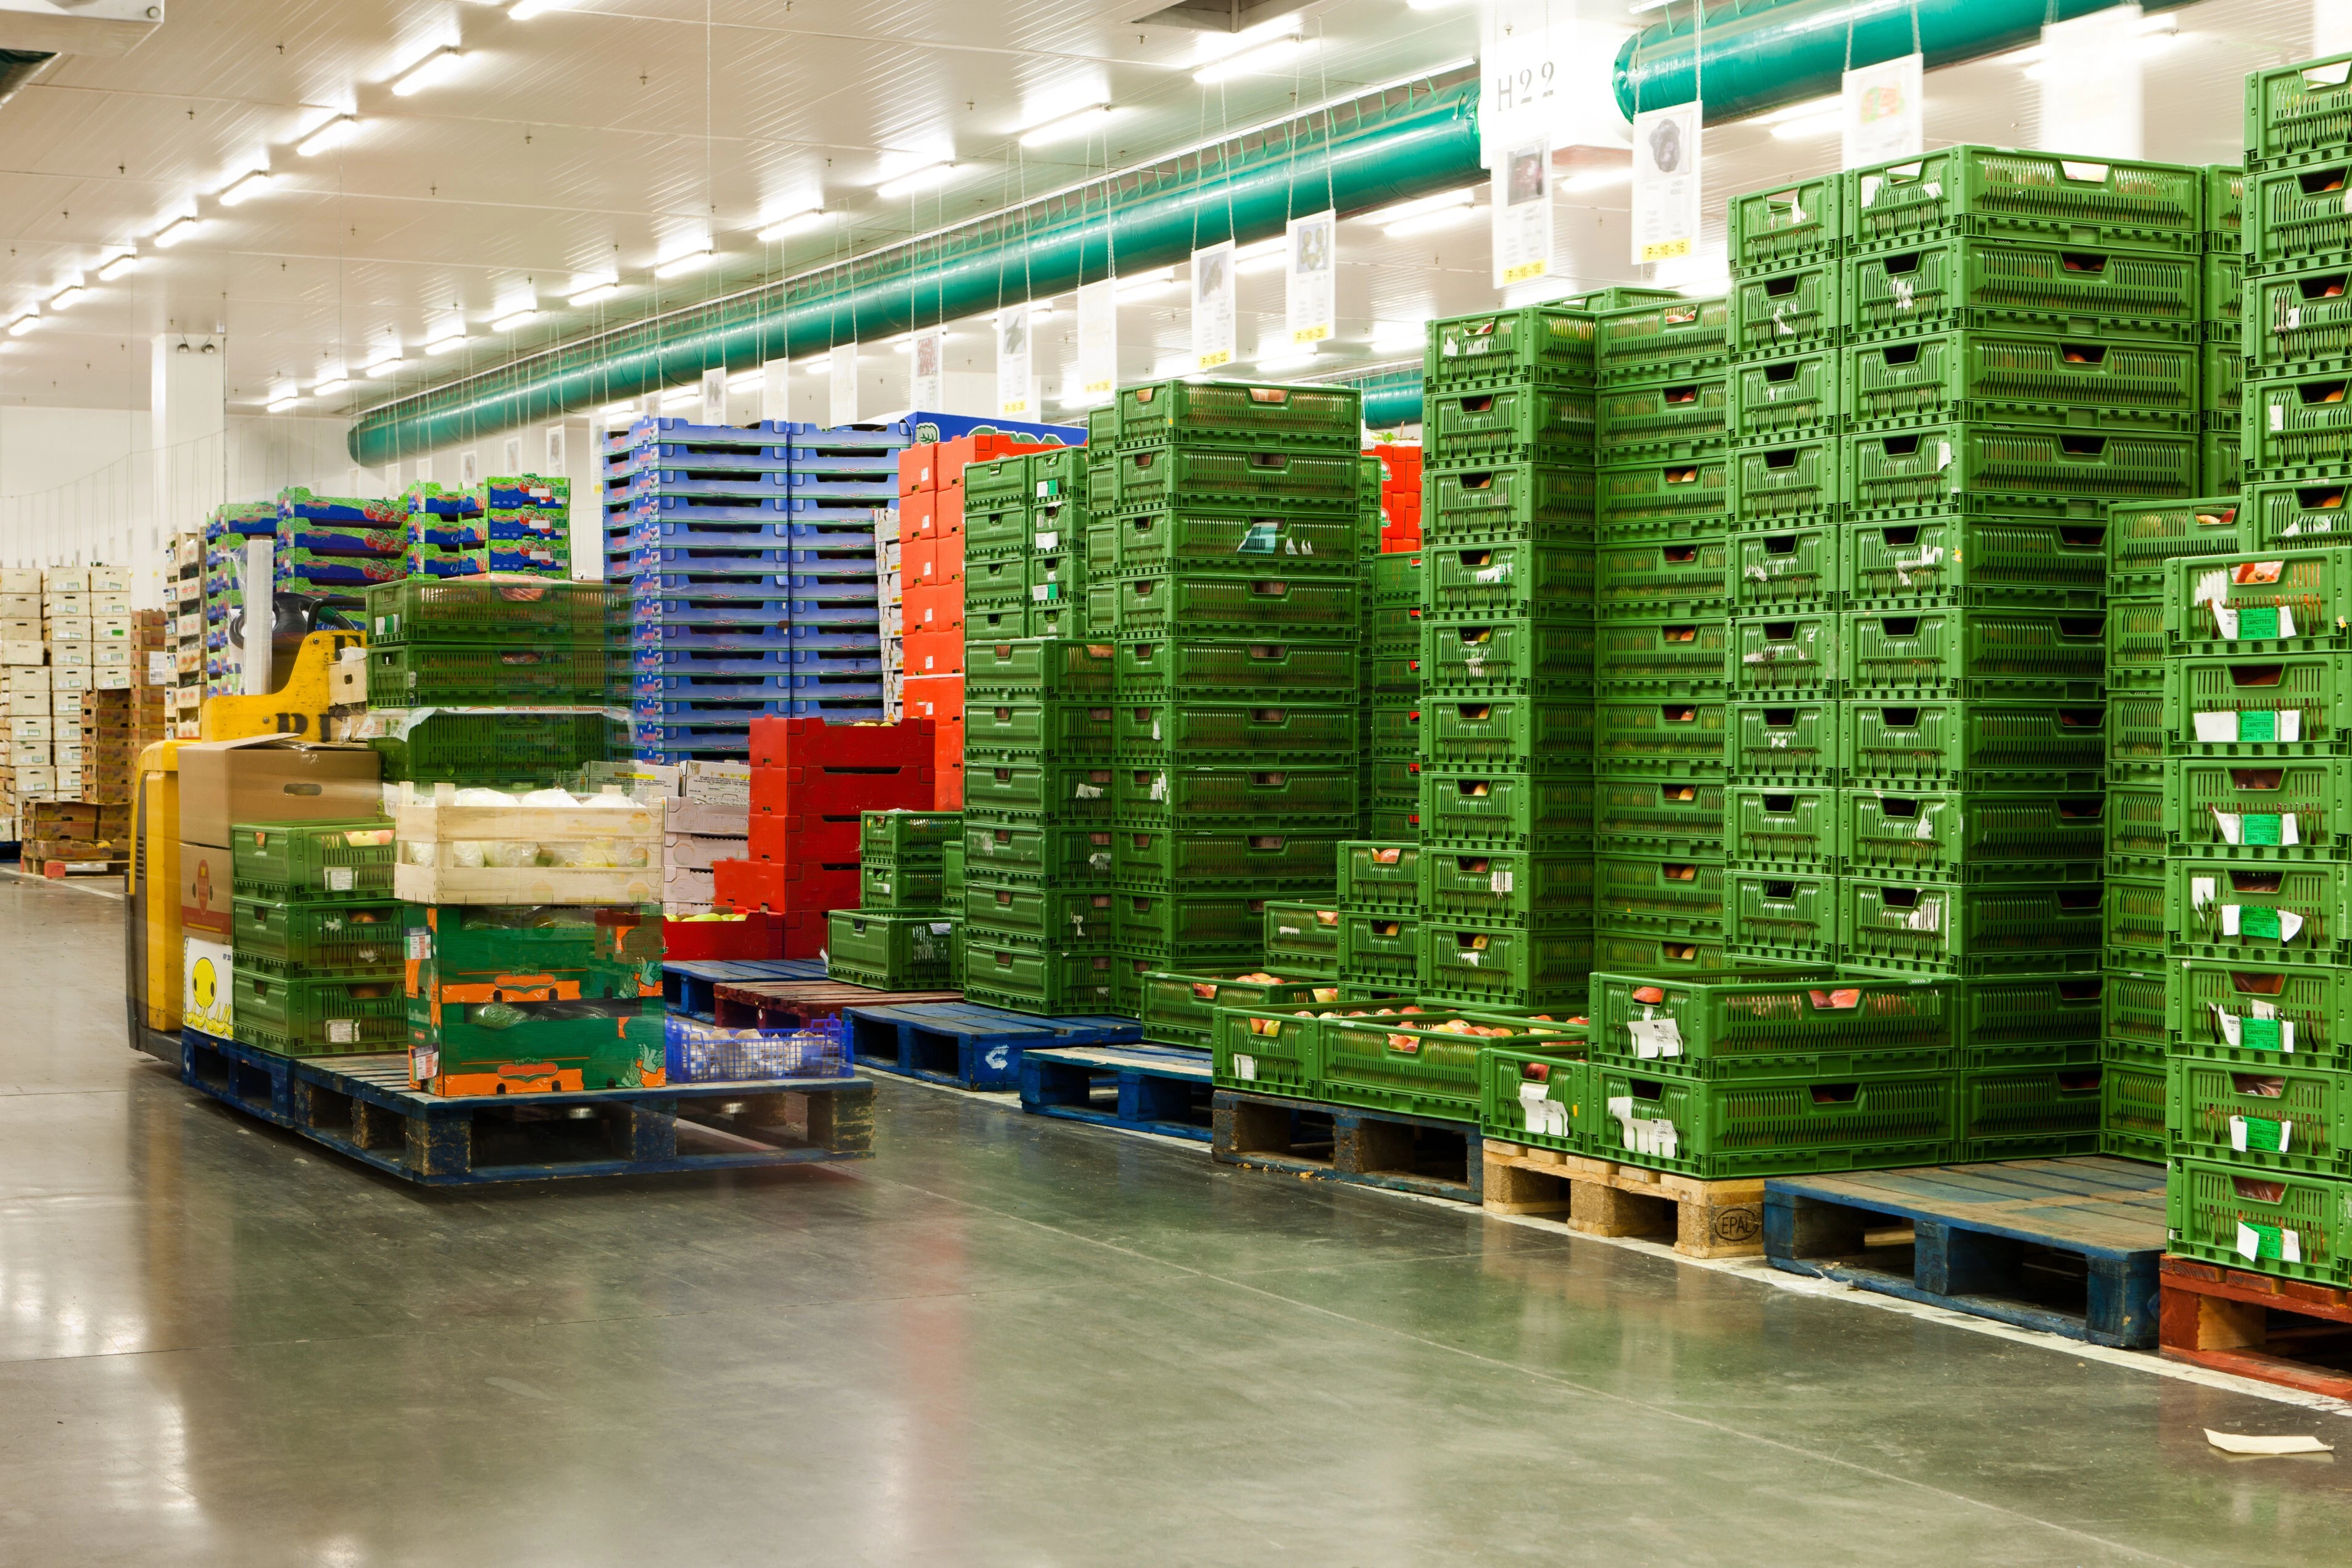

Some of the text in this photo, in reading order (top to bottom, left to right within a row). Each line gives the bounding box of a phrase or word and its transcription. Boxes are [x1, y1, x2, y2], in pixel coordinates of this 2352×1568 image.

[1497, 61, 1554, 112] H22
[442, 984, 453, 994] Le
[534, 988, 545, 999] Le
[445, 1075, 455, 1084] Le
[537, 1077, 548, 1087] Le
[2253, 1129, 2279, 1137] CAROTTES
[1721, 1216, 1753, 1234] EPAL
